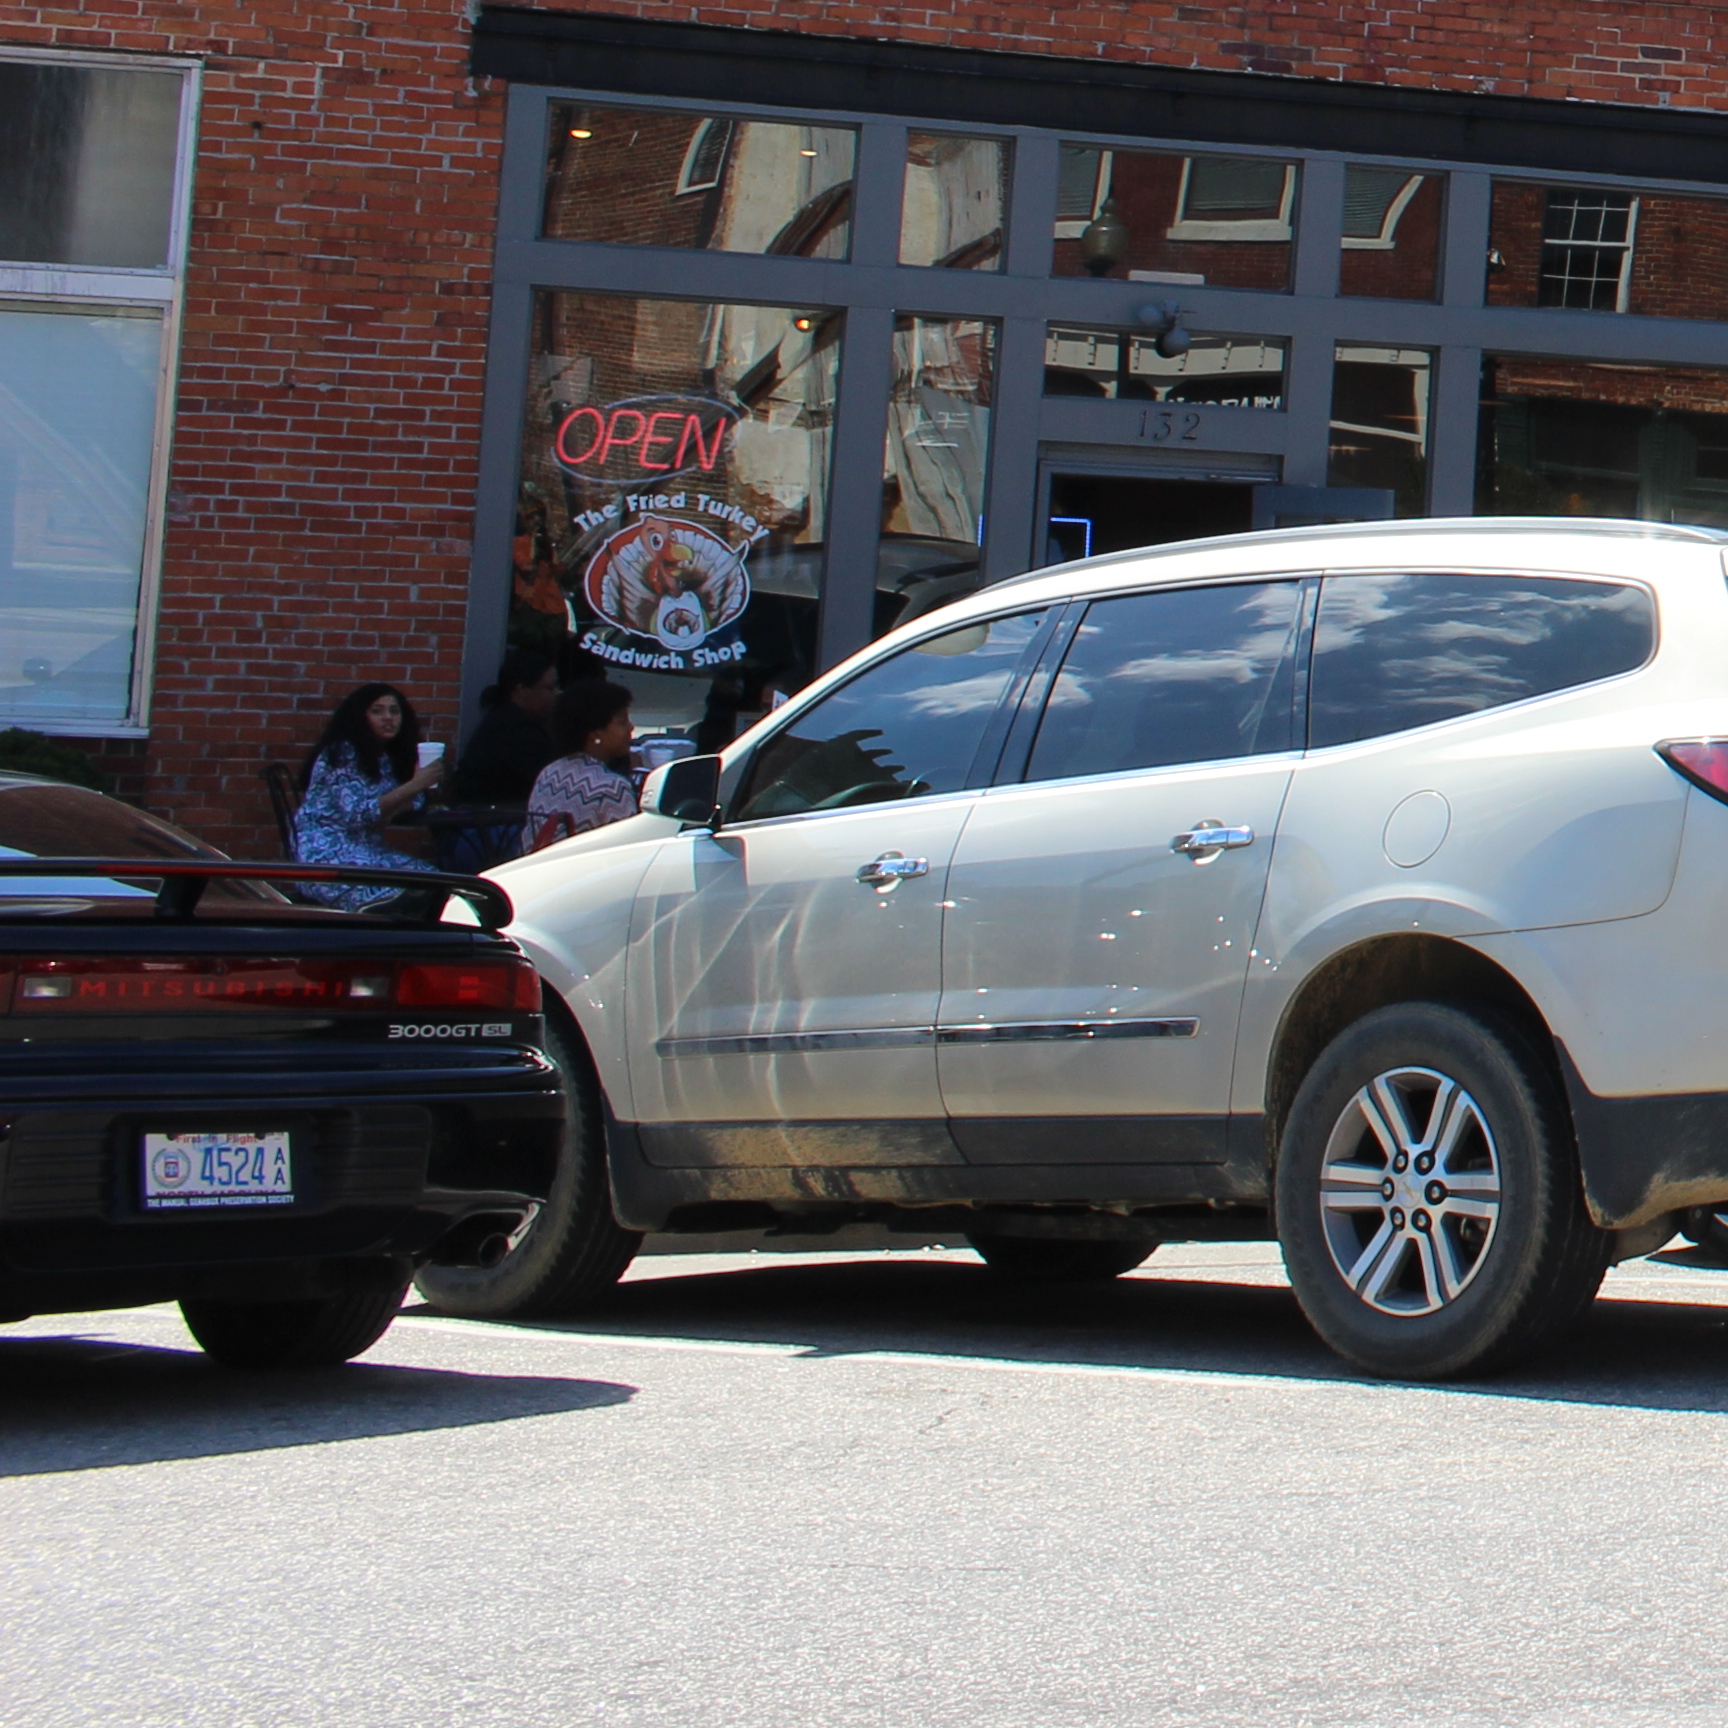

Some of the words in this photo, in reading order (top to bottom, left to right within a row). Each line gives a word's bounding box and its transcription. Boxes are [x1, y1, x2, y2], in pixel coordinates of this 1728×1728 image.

[556, 406, 727, 470] OPEN
[1139, 409, 1201, 441] 132
[574, 503, 619, 532] The
[626, 492, 686, 512] Fried
[697, 494, 771, 542] Turkey
[579, 632, 685, 669] Sandwich
[692, 641, 747, 667] Shop
[79, 980, 344, 997] MITSUBISHI
[388, 1023, 481, 1038] 3000GT
[200, 1147, 265, 1186] 4524
